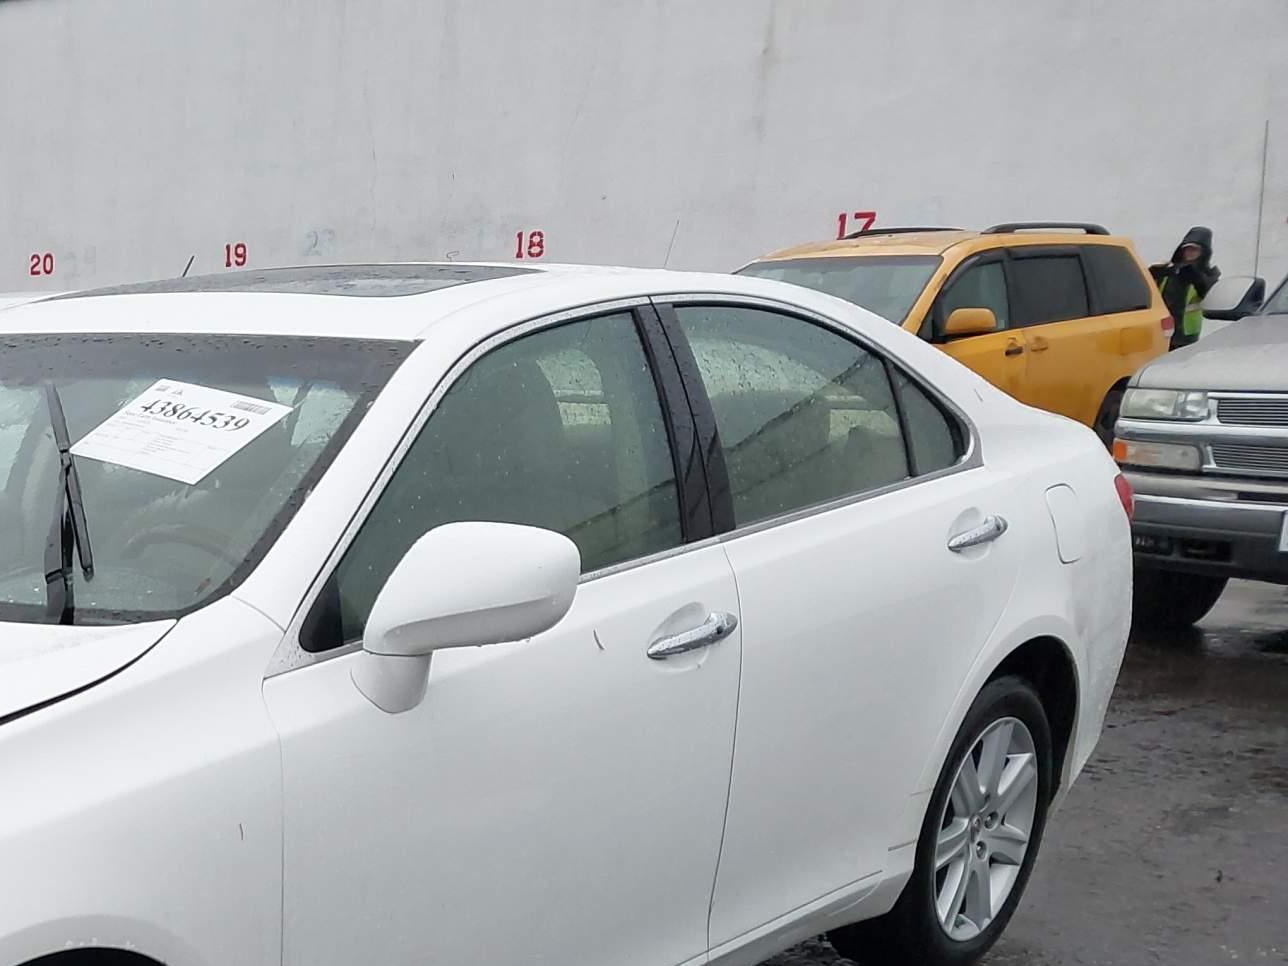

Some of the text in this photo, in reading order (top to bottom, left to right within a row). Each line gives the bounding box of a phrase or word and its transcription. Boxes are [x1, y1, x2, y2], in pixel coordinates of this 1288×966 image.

[836, 212, 877, 240] 17
[225, 243, 247, 268] 19
[515, 231, 544, 259] 18
[30, 253, 54, 276] 20
[140, 399, 251, 433] 43864539
